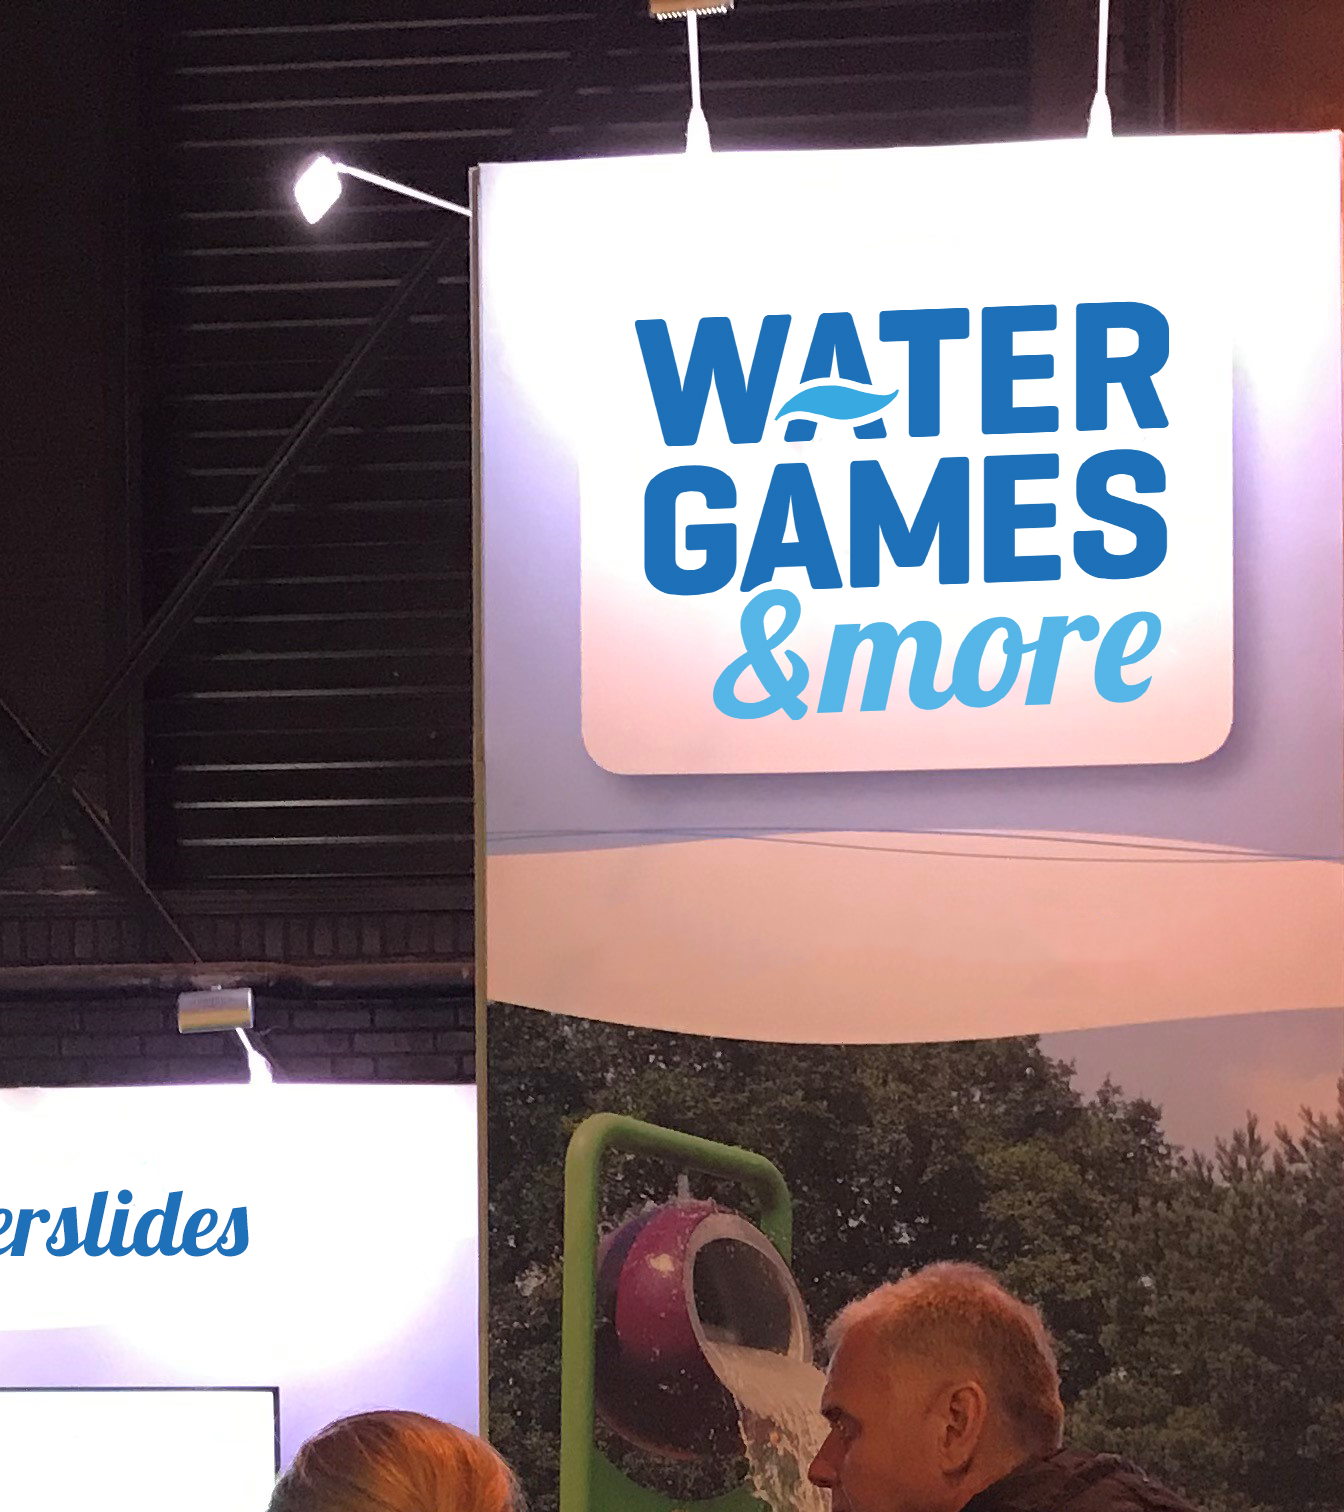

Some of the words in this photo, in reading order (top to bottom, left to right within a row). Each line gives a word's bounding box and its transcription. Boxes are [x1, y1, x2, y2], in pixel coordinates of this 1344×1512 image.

[635, 301, 1169, 447] WATER
[644, 449, 1168, 596] GAMES
[713, 589, 1163, 721] &more
